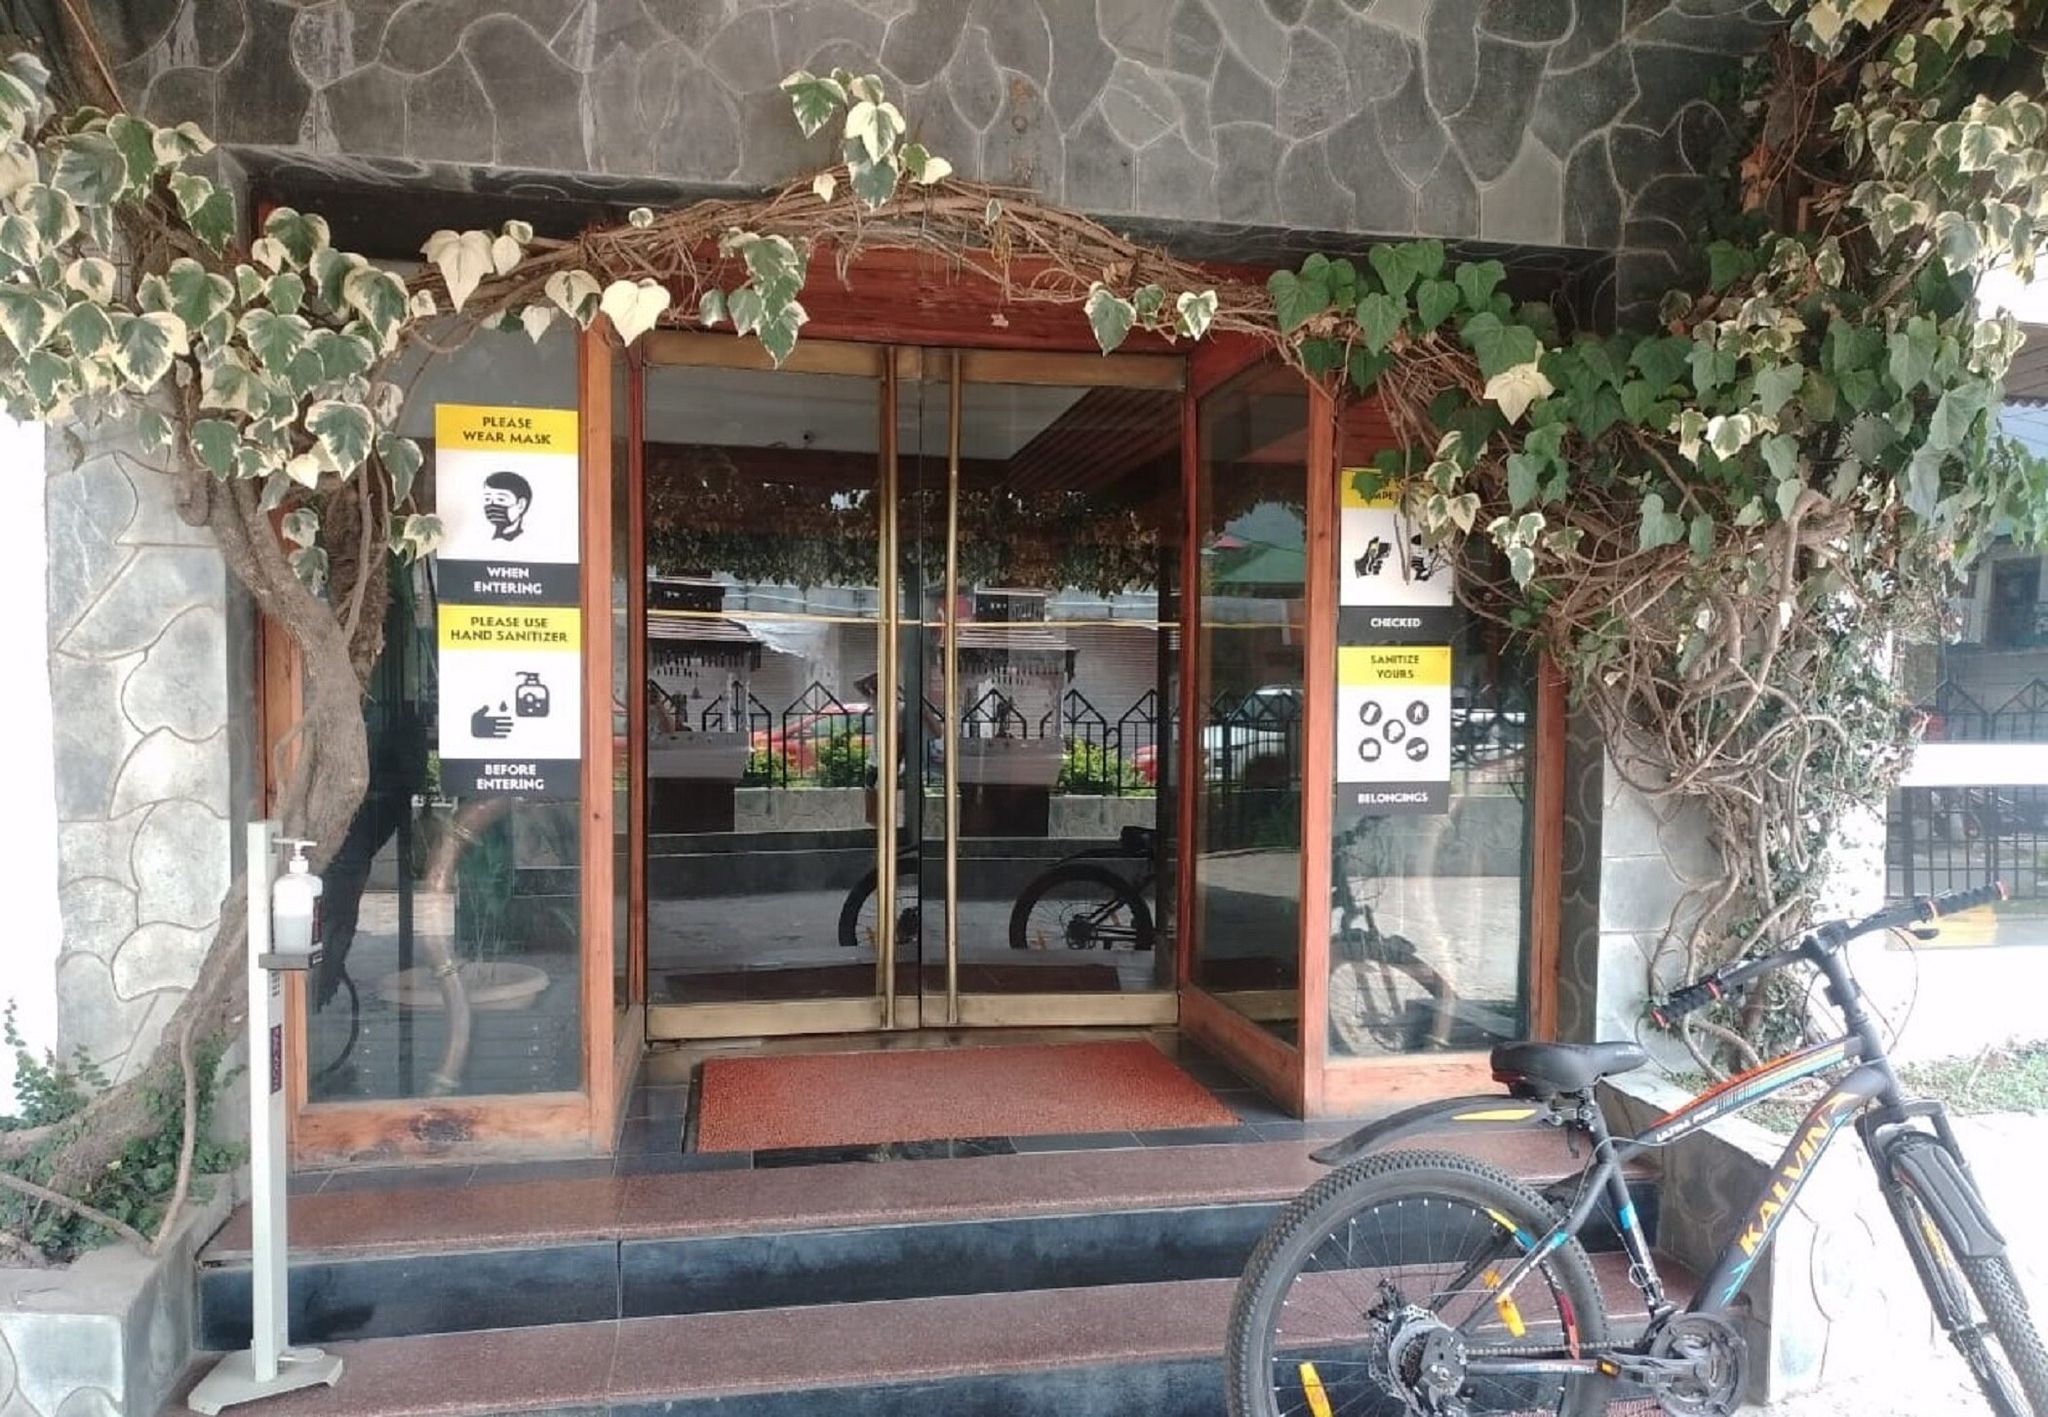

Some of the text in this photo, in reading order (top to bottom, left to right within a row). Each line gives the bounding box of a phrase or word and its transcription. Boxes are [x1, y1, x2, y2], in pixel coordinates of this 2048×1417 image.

[482, 416, 532, 430] PLEASE
[462, 430, 551, 446] WEAR MASK
[486, 566, 530, 579] WHEN
[473, 580, 542, 595] ENTERING
[470, 616, 548, 629] PLEASE USE
[1370, 617, 1421, 629] CHECKED
[450, 629, 568, 643] HAND SANITIZER
[1370, 654, 1420, 665] SANITIZE
[1376, 669, 1415, 680] YOURS
[484, 763, 537, 777] BEFORE
[476, 778, 545, 793] ENTERING
[1357, 791, 1429, 804] BELONGINGS
[1738, 1116, 1830, 1257] KALVIN
